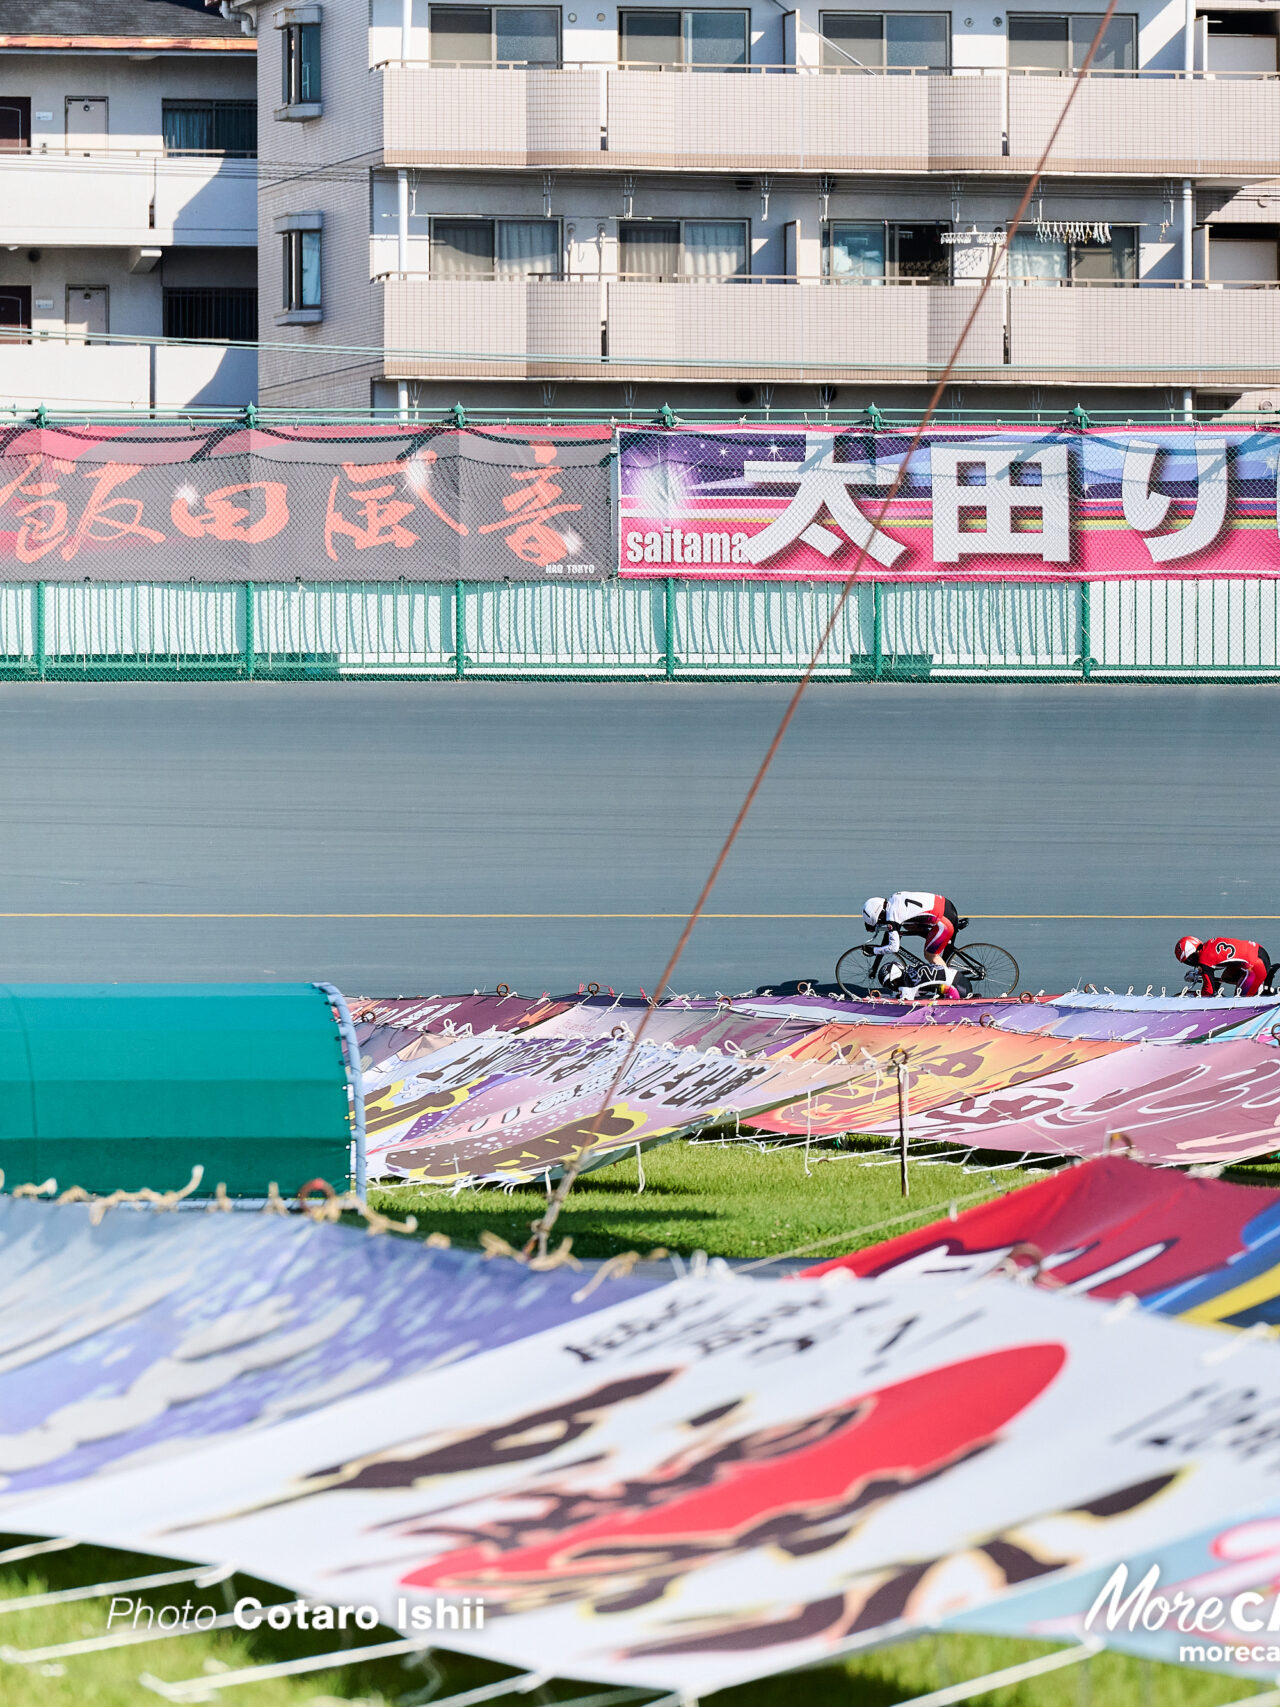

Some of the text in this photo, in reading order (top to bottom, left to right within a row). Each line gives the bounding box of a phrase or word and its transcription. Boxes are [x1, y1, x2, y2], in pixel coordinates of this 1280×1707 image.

[626, 526, 747, 565] saitama
[905, 898, 923, 908] 1
[1216, 941, 1236, 960] 3
[917, 965, 937, 982] 2
